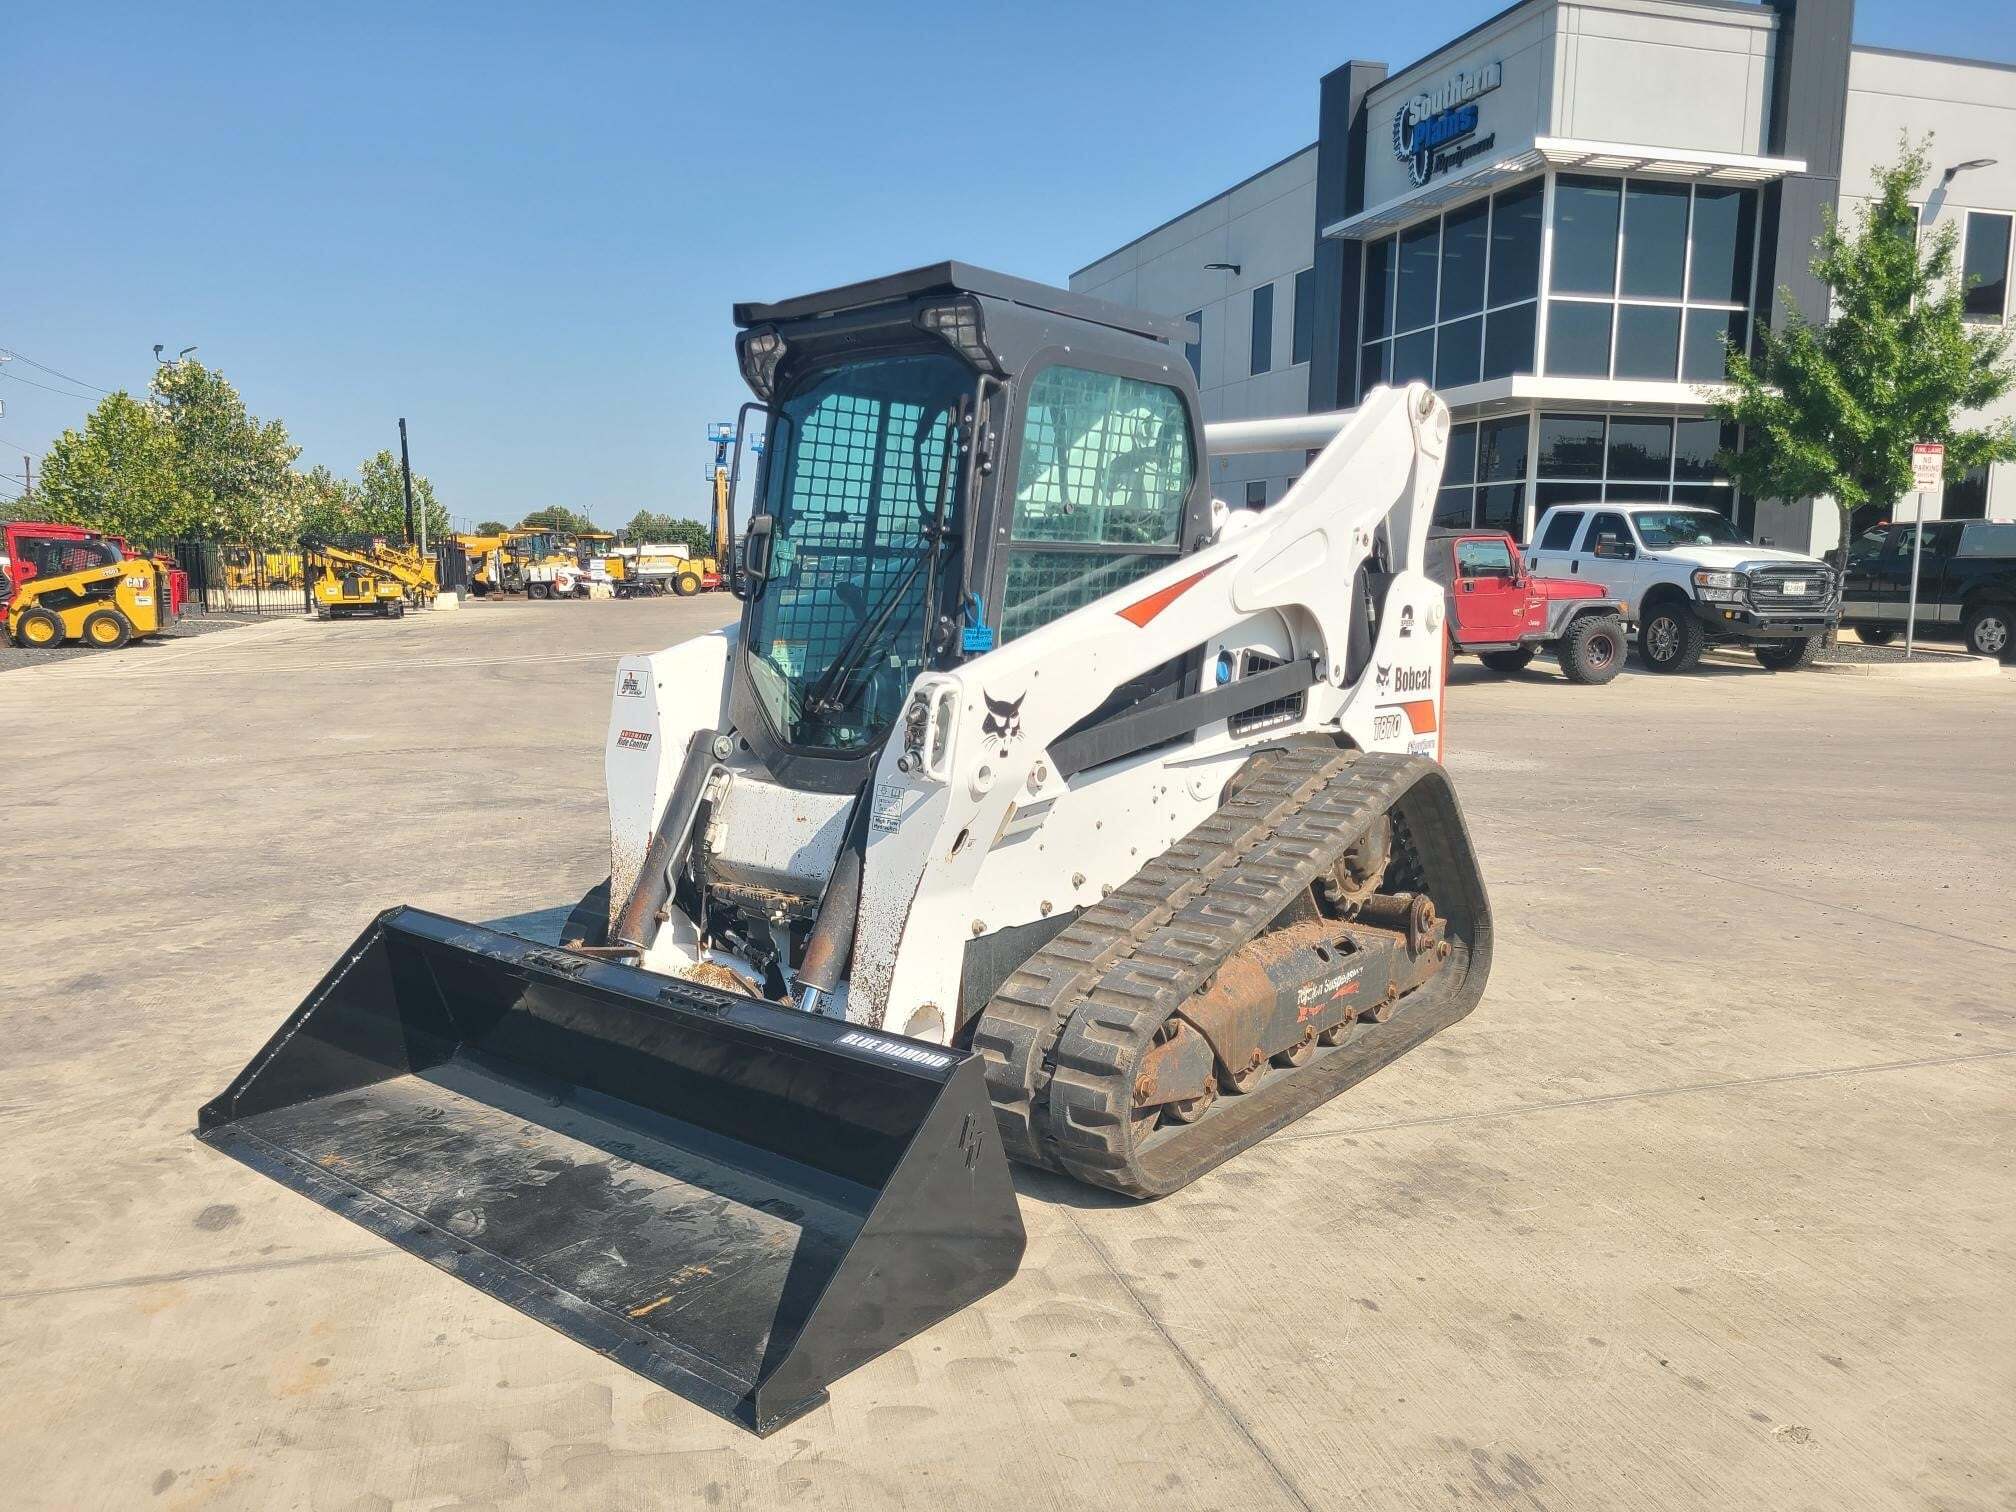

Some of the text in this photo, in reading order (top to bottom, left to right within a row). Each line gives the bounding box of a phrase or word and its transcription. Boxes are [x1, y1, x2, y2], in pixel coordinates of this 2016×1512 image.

[1408, 61, 1502, 126] Southern
[126, 577, 144, 588] CAT
[1395, 666, 1432, 693] Bobcat
[1374, 714, 1401, 741] T870
[629, 739, 649, 750] Control
[841, 1033, 950, 1067] BLUE DIAMOND
